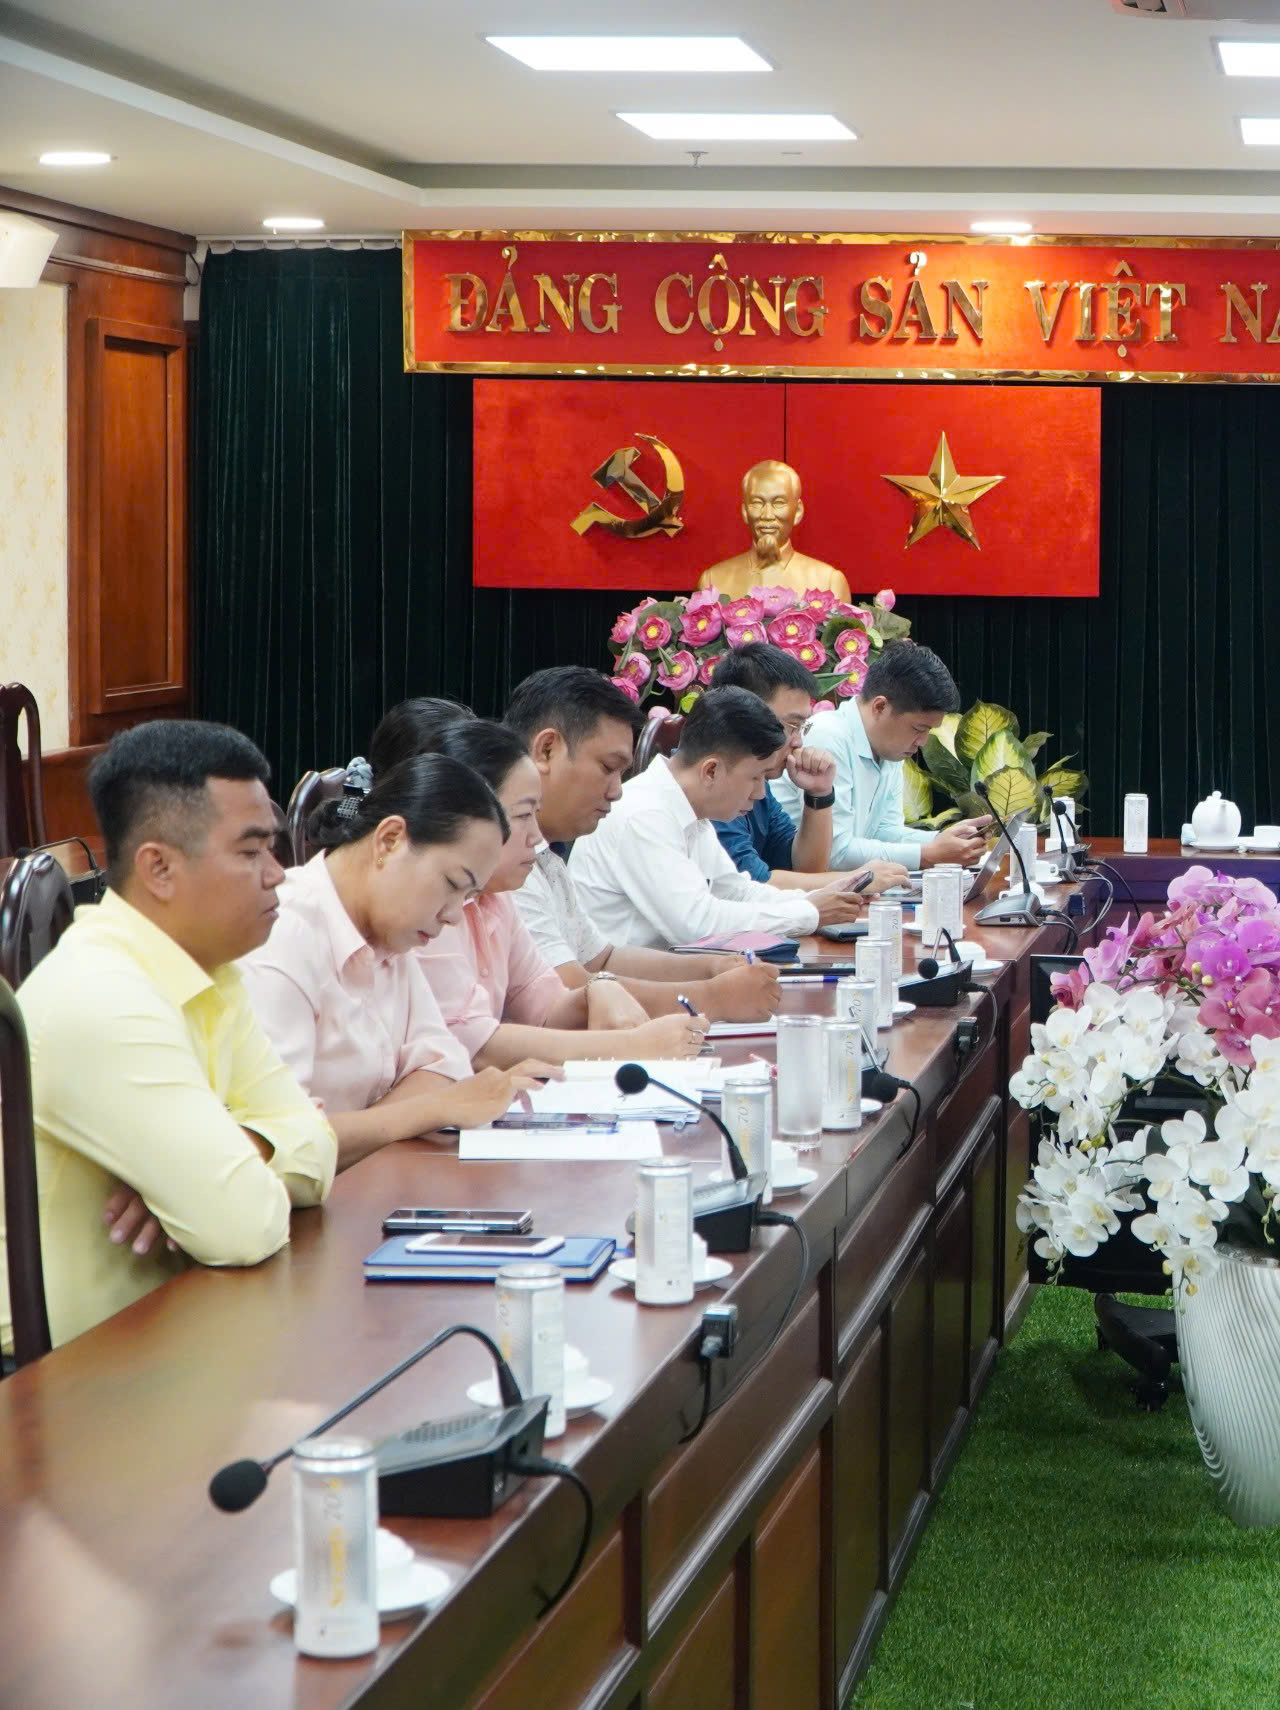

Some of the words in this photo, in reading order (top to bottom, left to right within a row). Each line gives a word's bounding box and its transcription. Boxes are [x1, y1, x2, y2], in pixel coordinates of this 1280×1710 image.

[445, 244, 621, 334] ĐẢNG
[655, 253, 828, 351] CỘNG
[857, 251, 987, 341] SẢN
[1025, 261, 1186, 357] VIỆT
